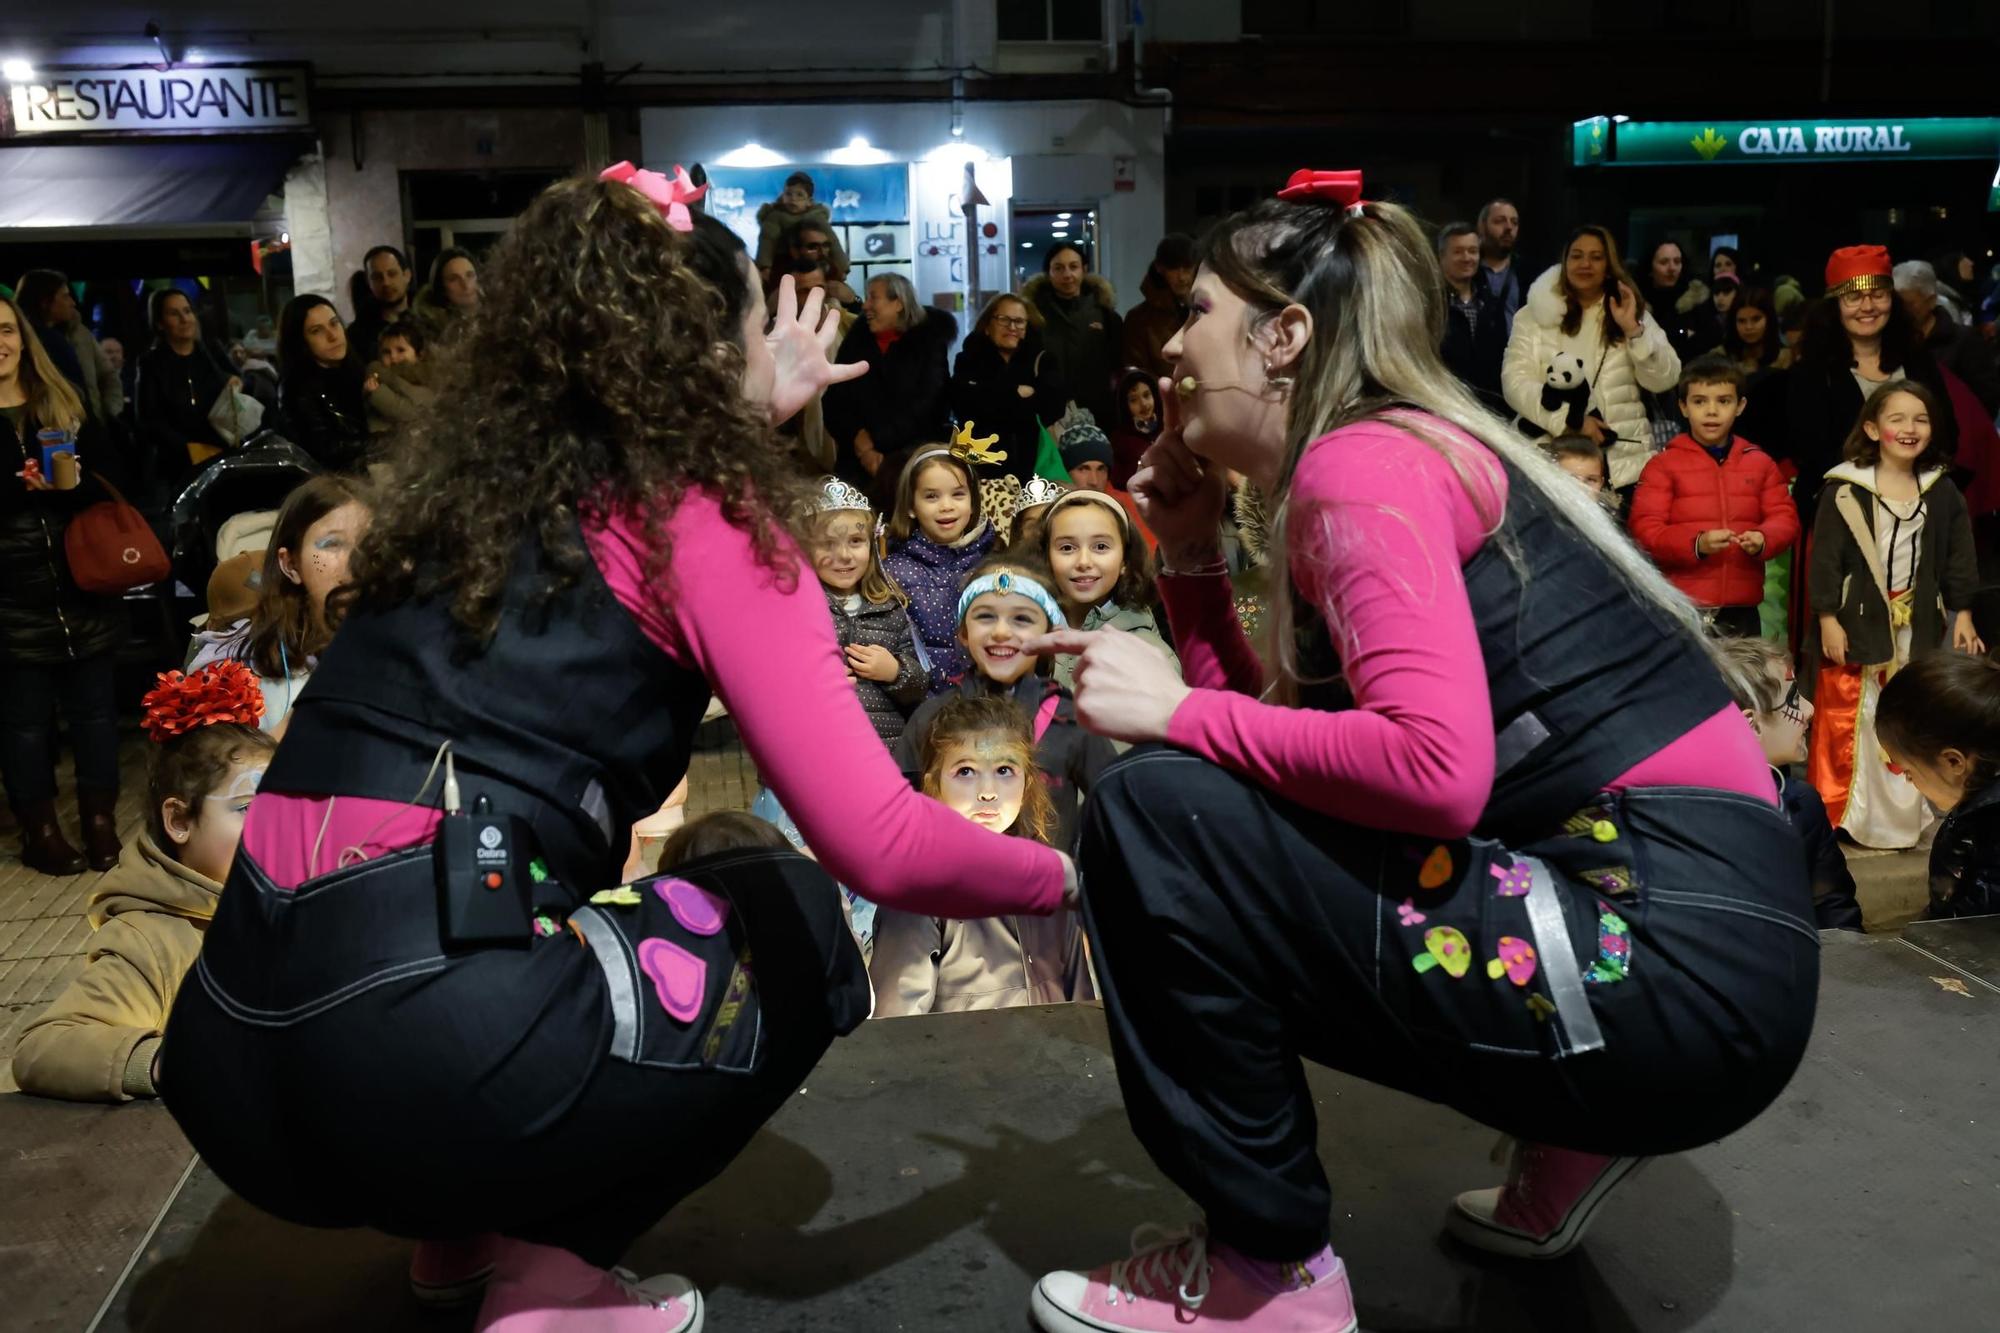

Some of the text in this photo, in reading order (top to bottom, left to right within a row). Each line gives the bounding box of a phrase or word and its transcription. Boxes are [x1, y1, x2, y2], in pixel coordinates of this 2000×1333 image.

[27, 76, 297, 120] RESTAURANTE
[1738, 125, 1911, 155] CAJA RURAL
